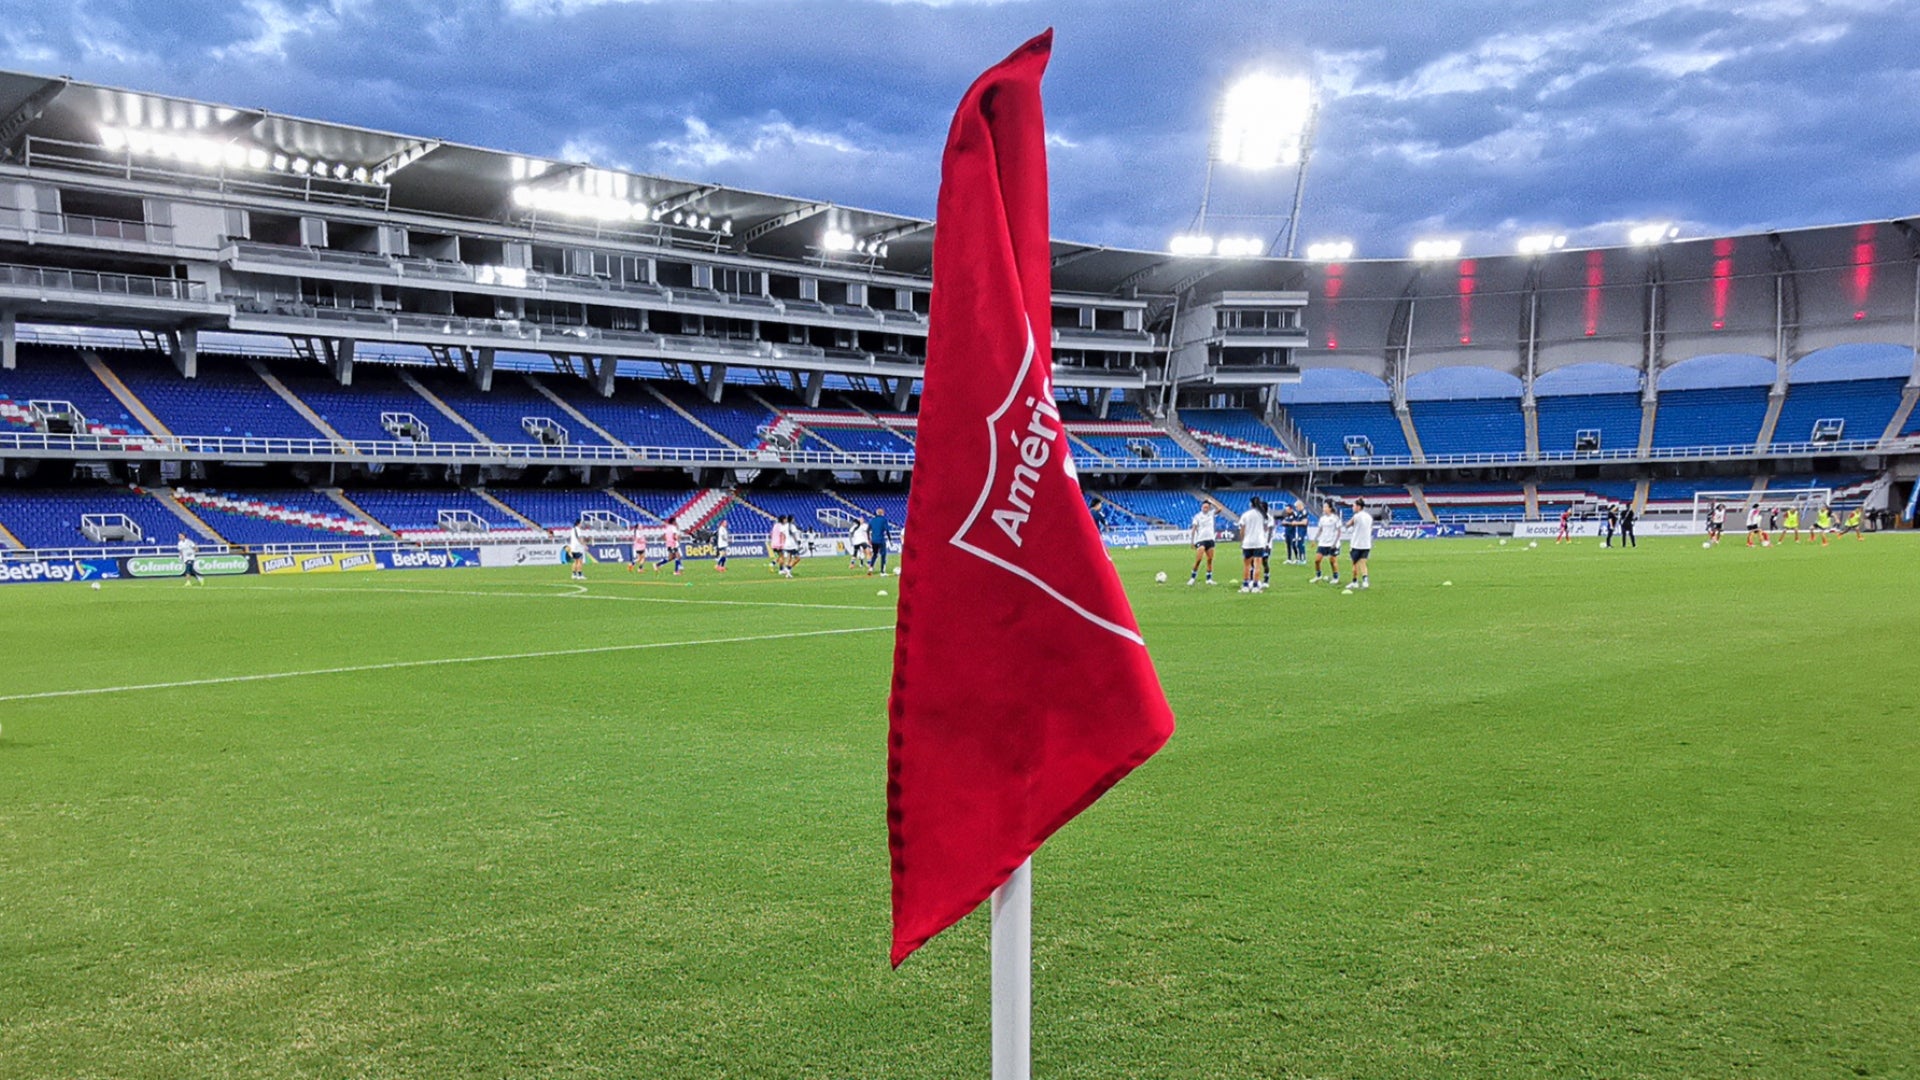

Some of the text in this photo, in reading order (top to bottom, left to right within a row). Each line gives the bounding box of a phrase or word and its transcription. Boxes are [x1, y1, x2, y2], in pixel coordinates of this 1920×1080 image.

[1377, 527, 1416, 539] BetPlay
[392, 551, 447, 567] BetPlay
[599, 548, 622, 559] LIGA
[0, 561, 74, 581] BetPlay
[130, 560, 184, 573] Colanta
[196, 558, 246, 571] Colanta
